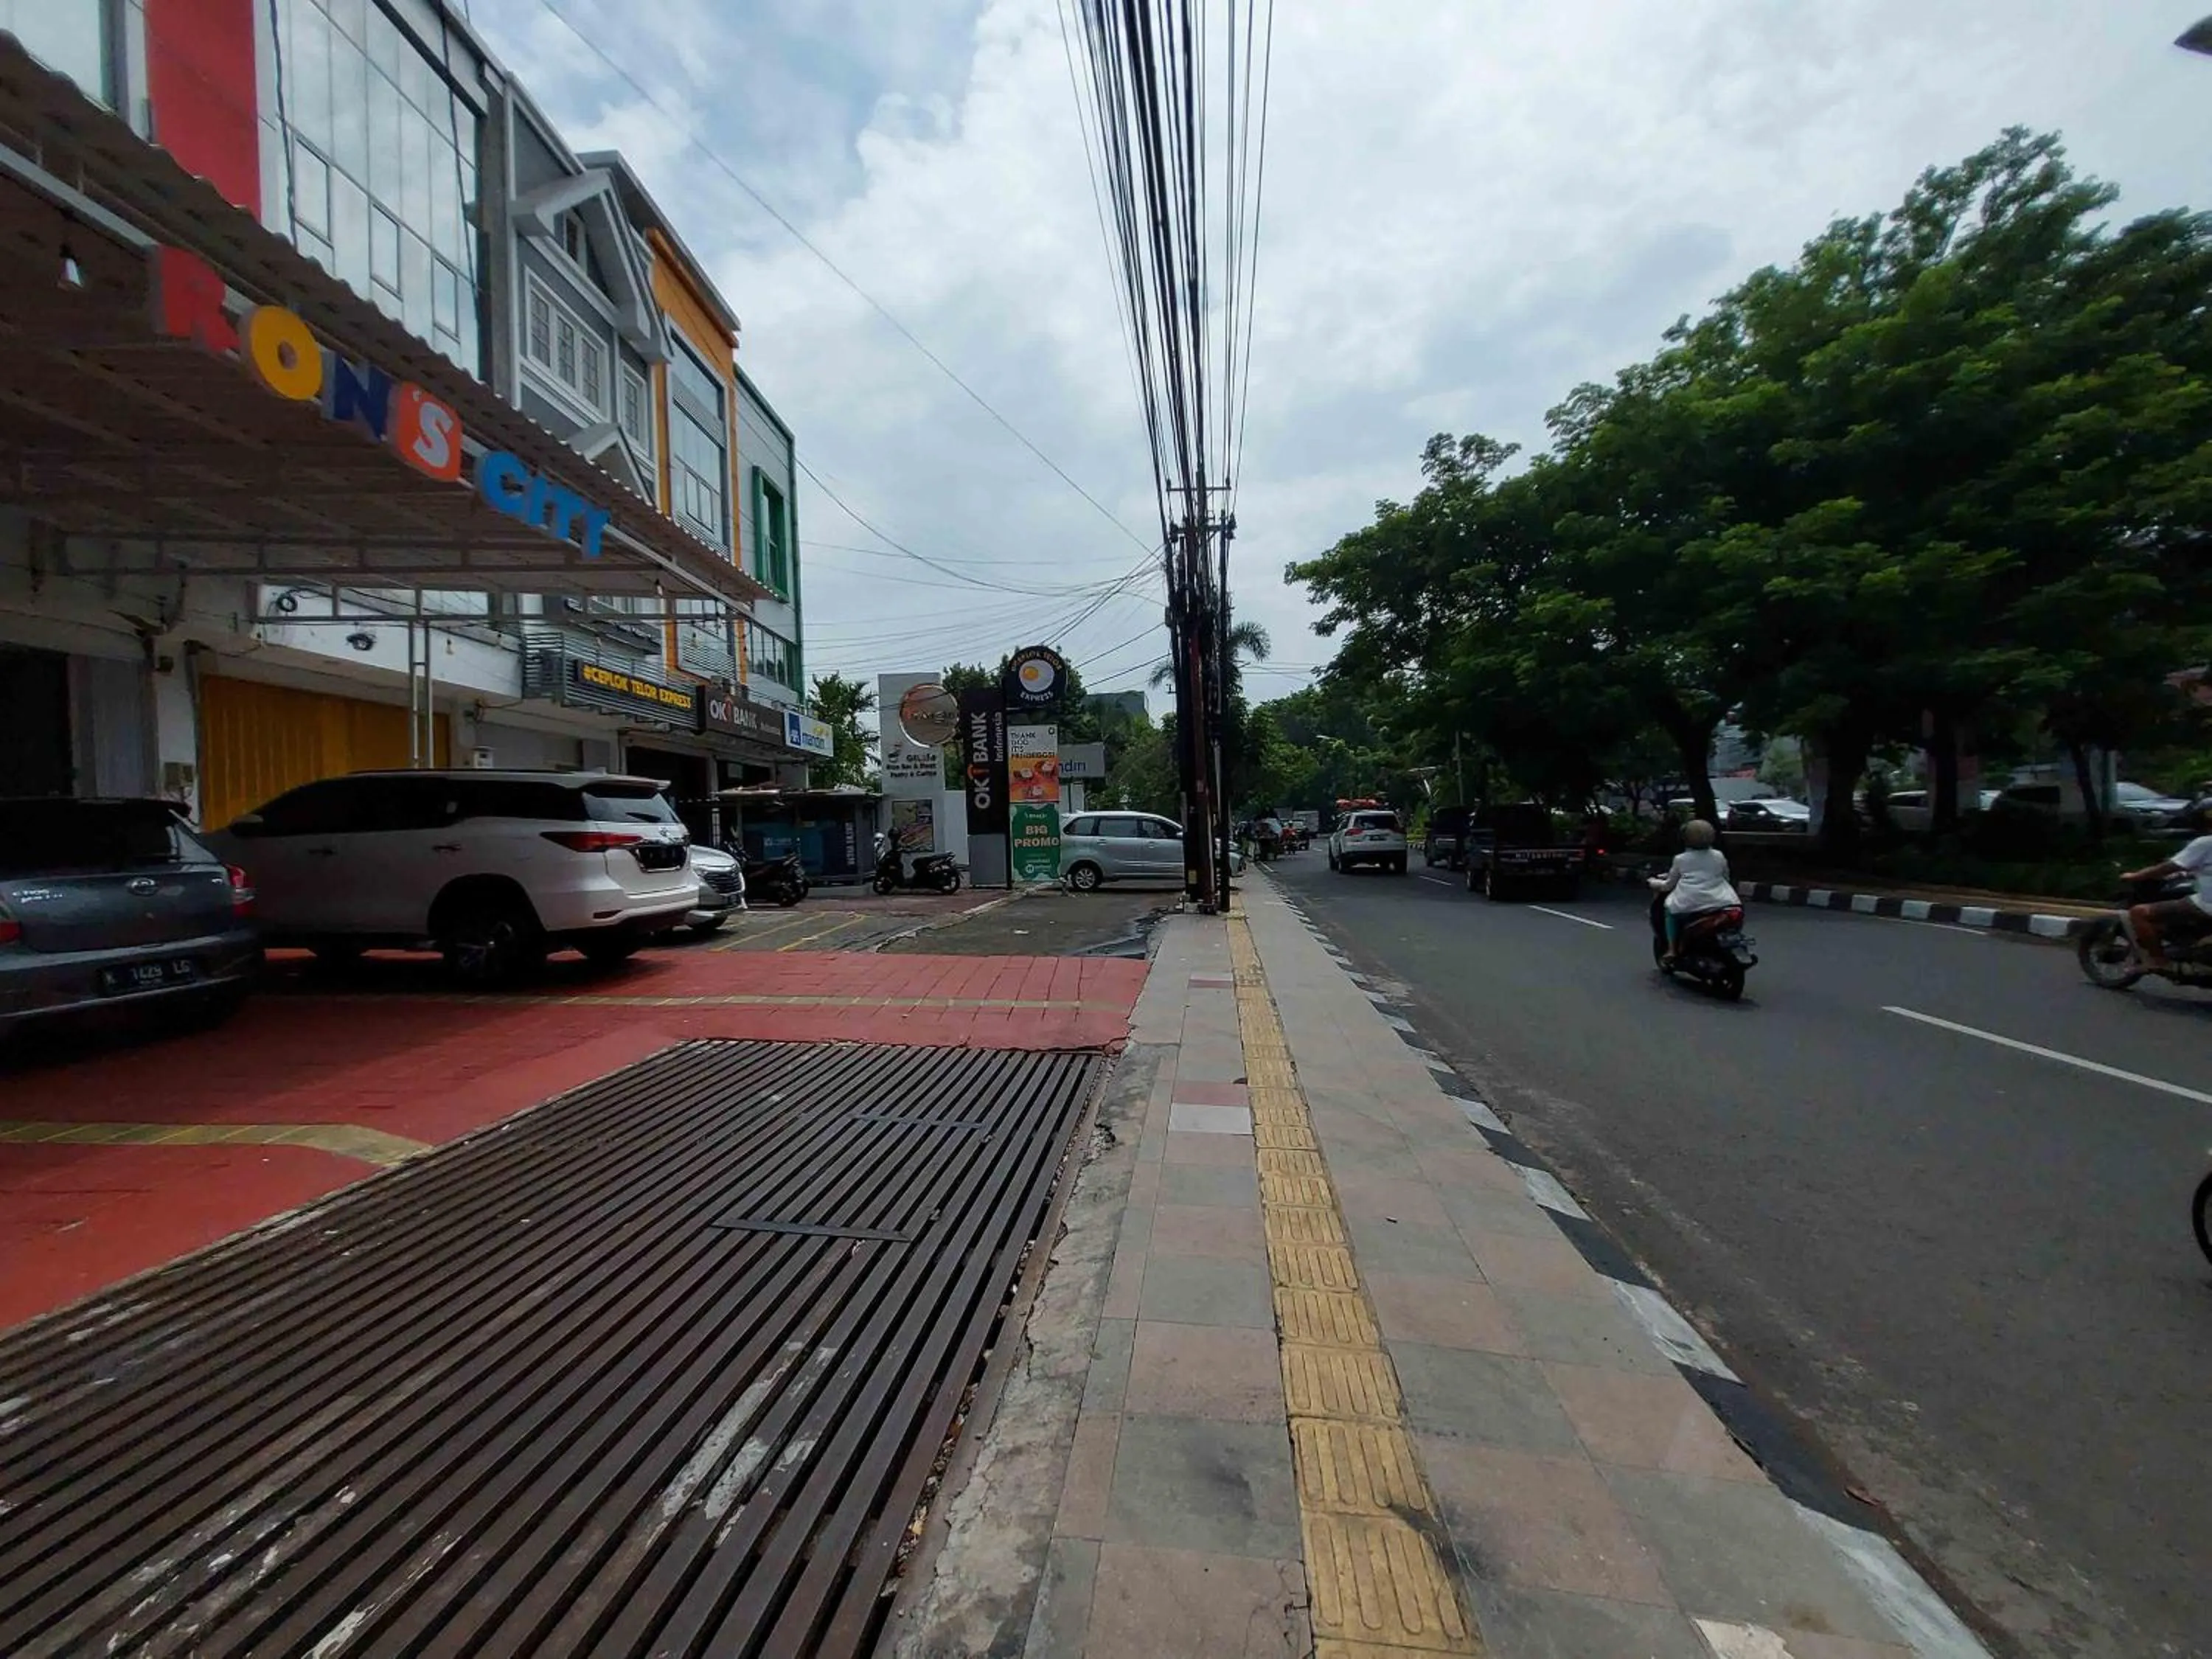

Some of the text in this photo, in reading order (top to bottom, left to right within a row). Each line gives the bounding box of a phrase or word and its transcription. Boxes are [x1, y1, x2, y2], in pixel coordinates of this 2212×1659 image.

[631, 681, 658, 699] TELOR
[660, 689, 691, 709] EXPRESS
[970, 712, 989, 762] BANK
[1026, 825, 1048, 835] BIG
[1014, 837, 1060, 848] PROMO
